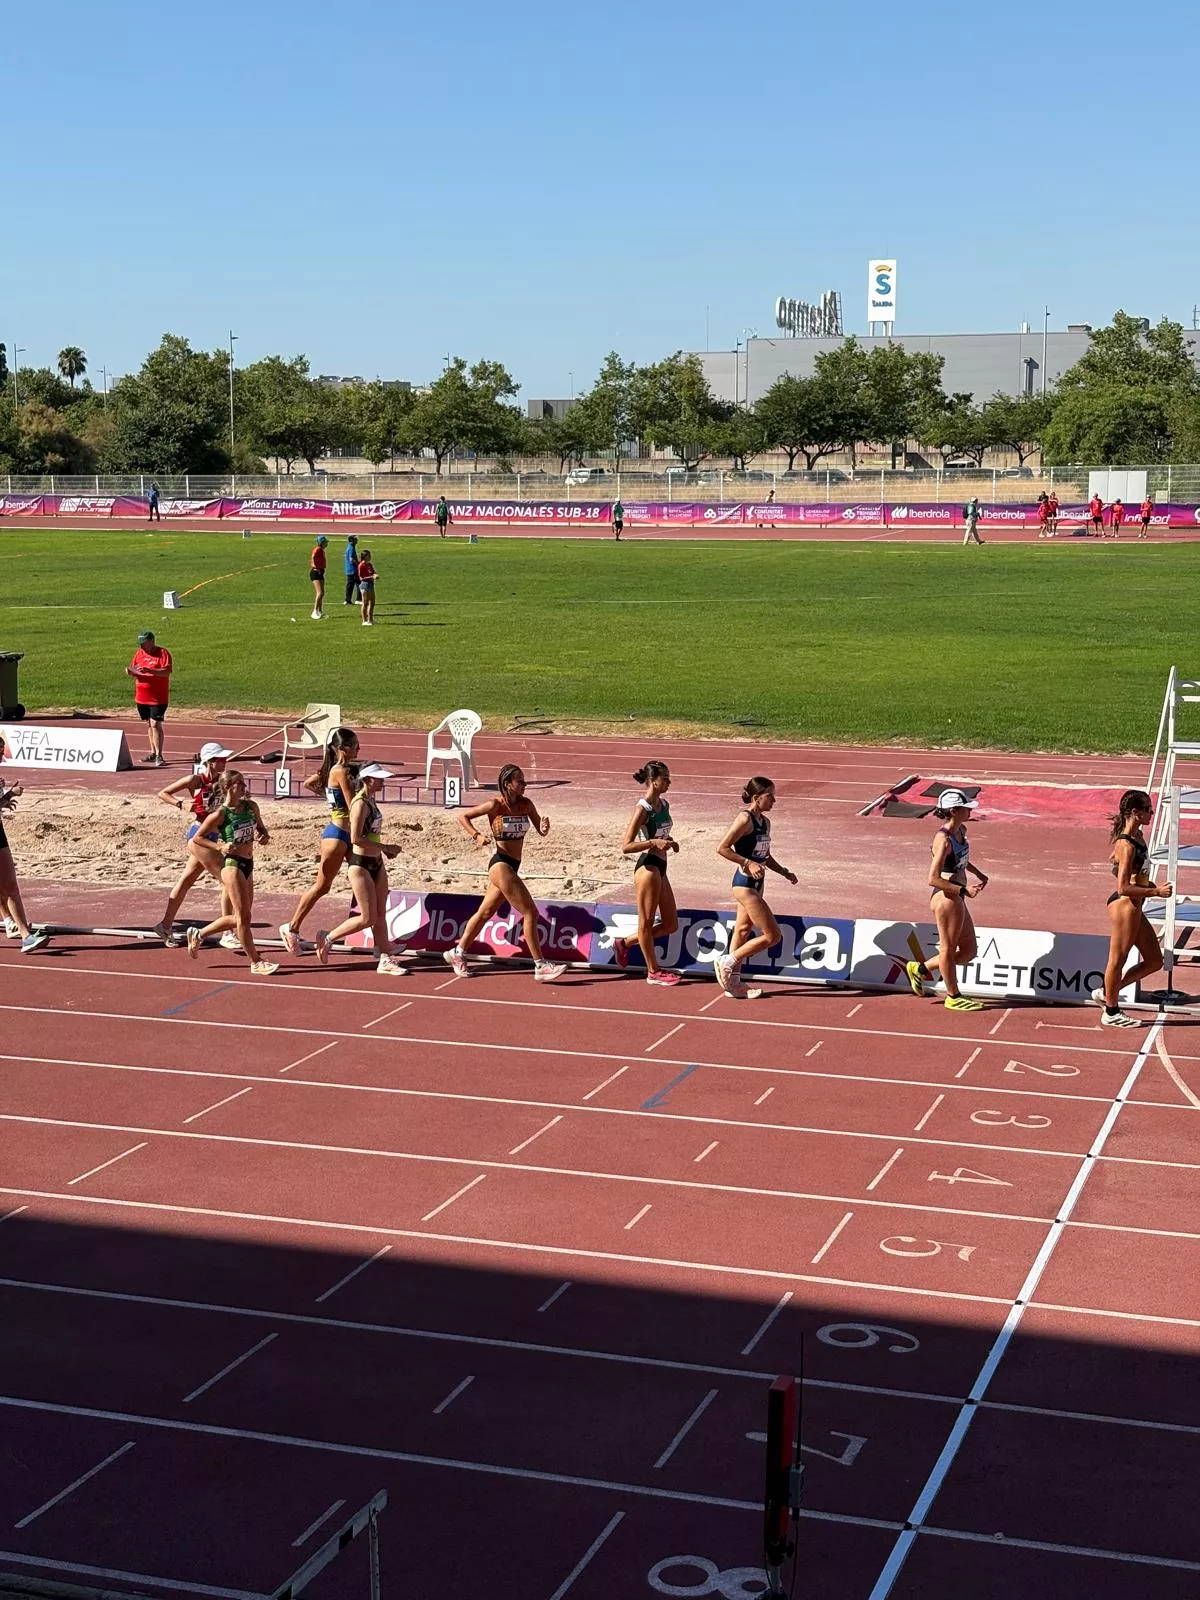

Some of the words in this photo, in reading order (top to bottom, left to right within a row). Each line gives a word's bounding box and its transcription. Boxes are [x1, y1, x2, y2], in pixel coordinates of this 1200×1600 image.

[271, 500, 303, 509] Futures
[304, 501, 316, 510] 32
[331, 502, 376, 516] Allianz
[421, 504, 474, 516] ALANZ
[475, 505, 554, 518] NACIONALES
[556, 507, 600, 519] SUB-18
[909, 508, 951, 519] Iberdrola
[983, 510, 1026, 519] Iberdrola
[10, 730, 50, 745] RFEA
[15, 746, 104, 764] ATLETISMO
[278, 771, 287, 790] 6
[448, 780, 456, 798] 8
[427, 909, 579, 950] Ibrdrola
[938, 962, 1106, 994] TLETISMO
[1034, 1020, 1104, 1031] 1
[1003, 1059, 1081, 1077] 2
[969, 1109, 1052, 1129] 3
[927, 1167, 1014, 1187] 4
[879, 1235, 977, 1262] 5
[815, 1322, 921, 1353] 6
[744, 1429, 868, 1466] 7
[647, 1554, 776, 1600] 8
